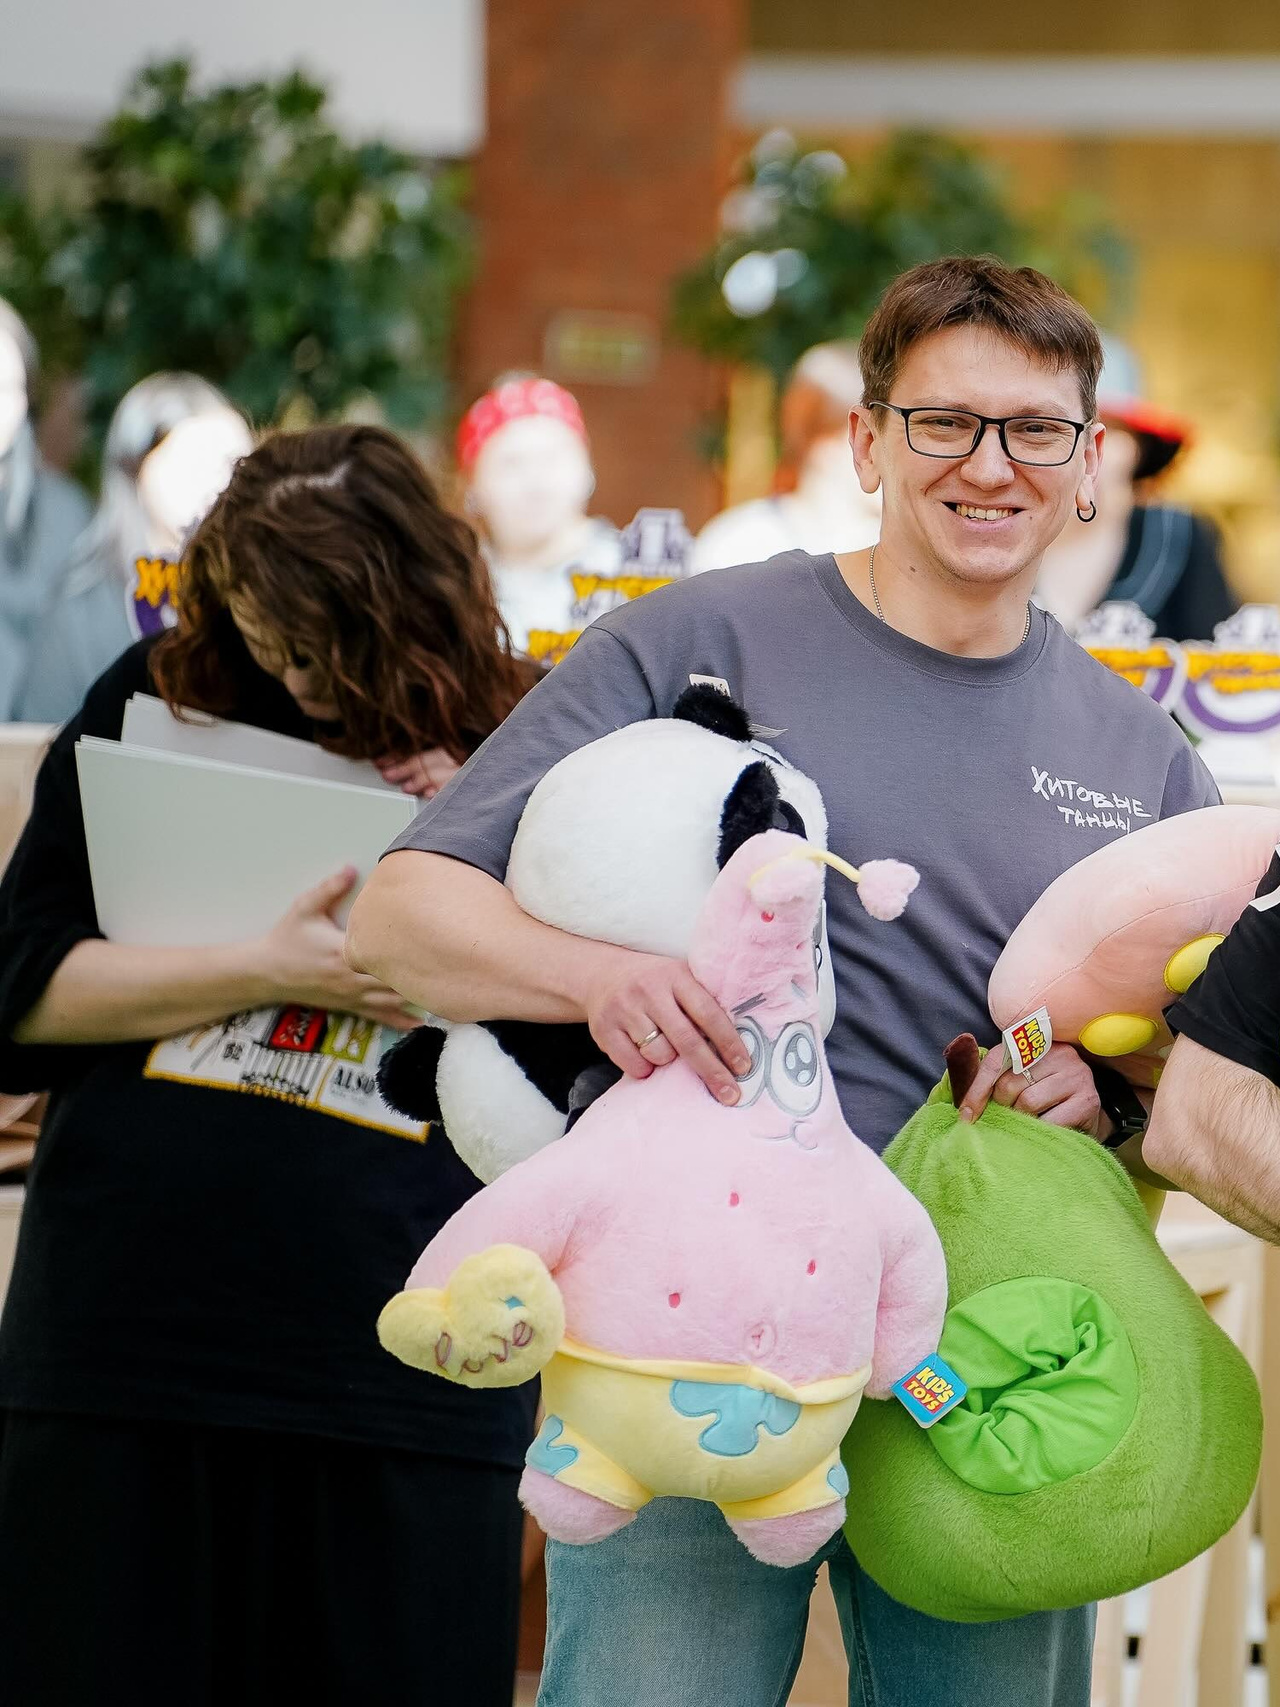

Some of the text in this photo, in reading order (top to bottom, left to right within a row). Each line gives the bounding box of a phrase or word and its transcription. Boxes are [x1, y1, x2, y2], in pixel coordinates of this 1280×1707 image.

[1030, 765, 1153, 818] ХИТОВЫЕ
[1056, 804, 1131, 835] ТАНЦЫ
[1014, 1030, 1032, 1064] TOYS
[1024, 1018, 1047, 1059] KID'S
[906, 1380, 940, 1411] TOYS
[915, 1366, 955, 1404] KID'S
